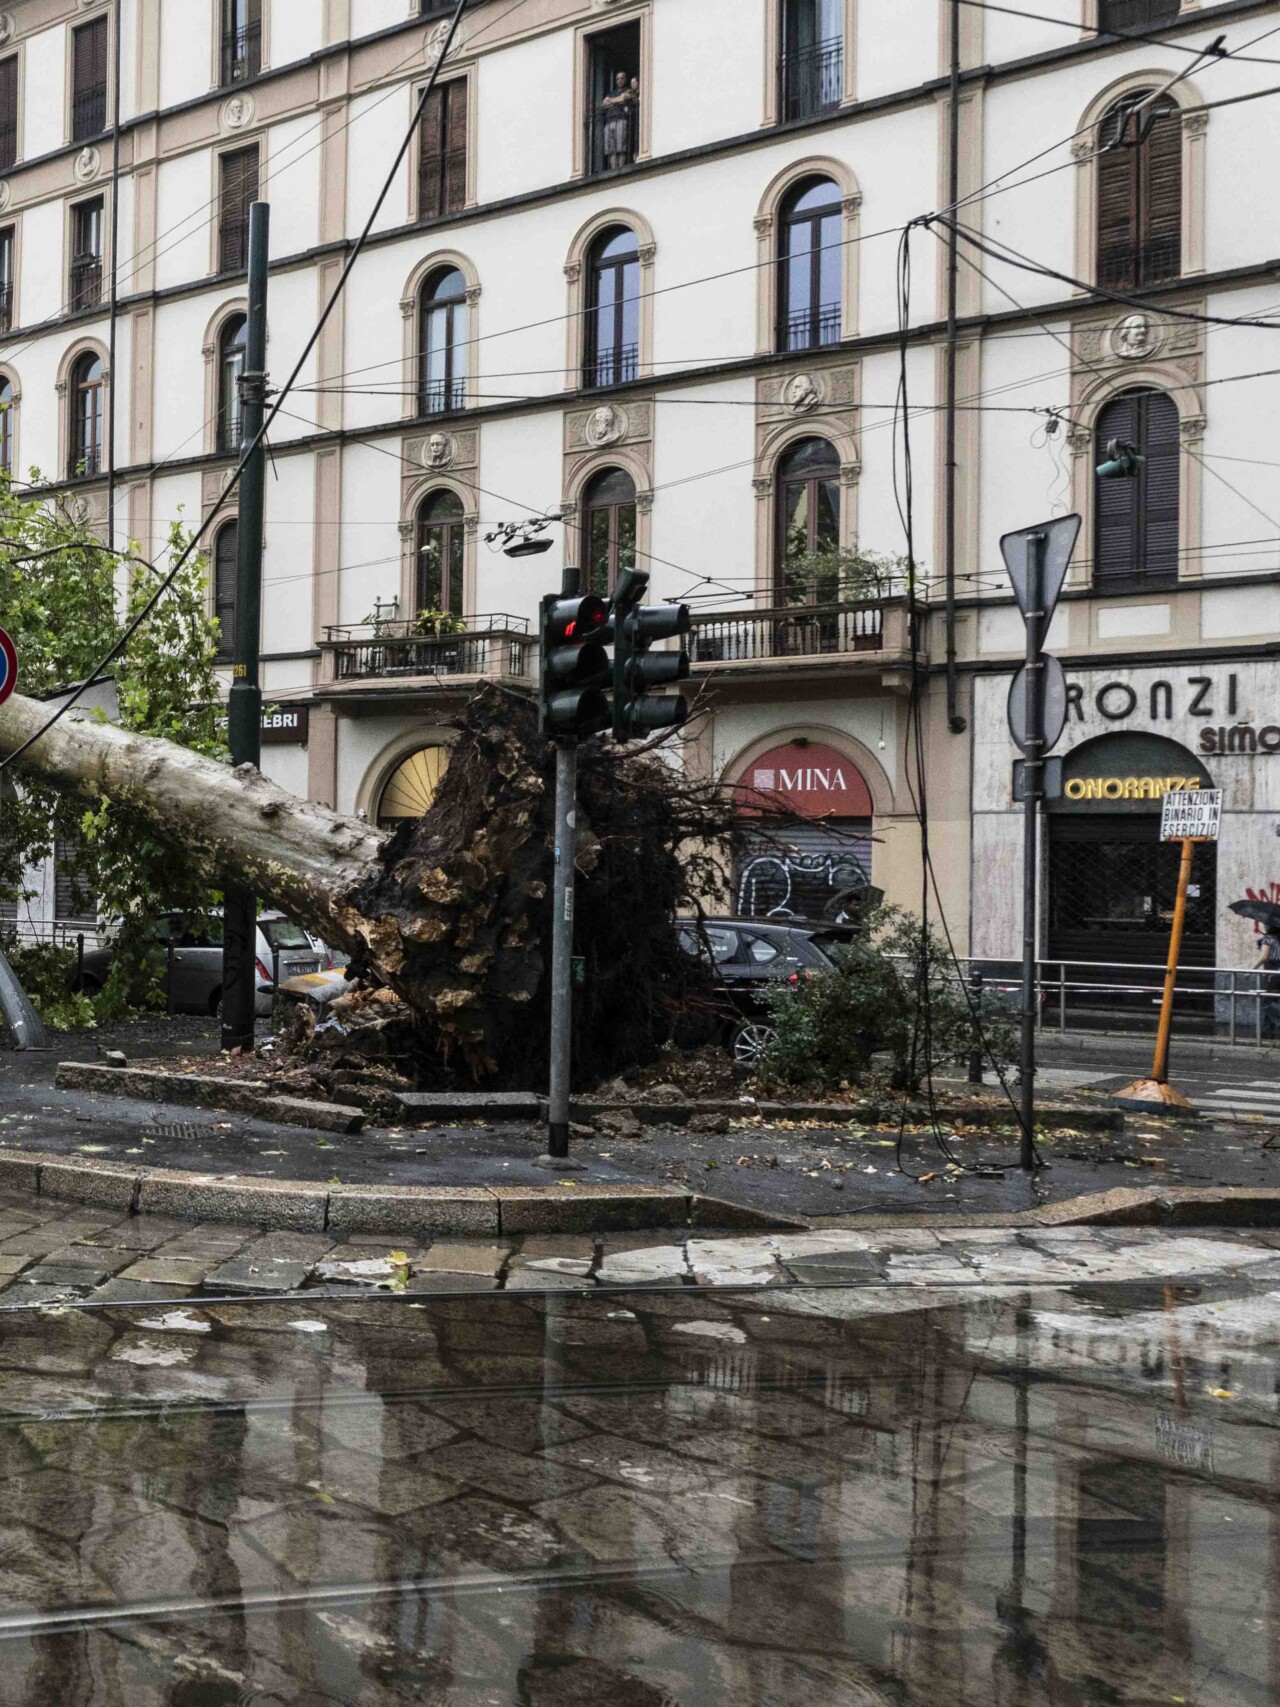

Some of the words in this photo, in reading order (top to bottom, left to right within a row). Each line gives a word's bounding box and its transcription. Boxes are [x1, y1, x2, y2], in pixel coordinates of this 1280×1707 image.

[260, 713, 298, 728] EBRI
[778, 768, 847, 791] MINA
[1064, 776, 1201, 800] ONORANZE
[1165, 791, 1221, 807] ATTENZIONE
[1163, 807, 1203, 822] BINARIO
[1208, 807, 1219, 821] IN
[1162, 823, 1218, 837] ESERCIZIO
